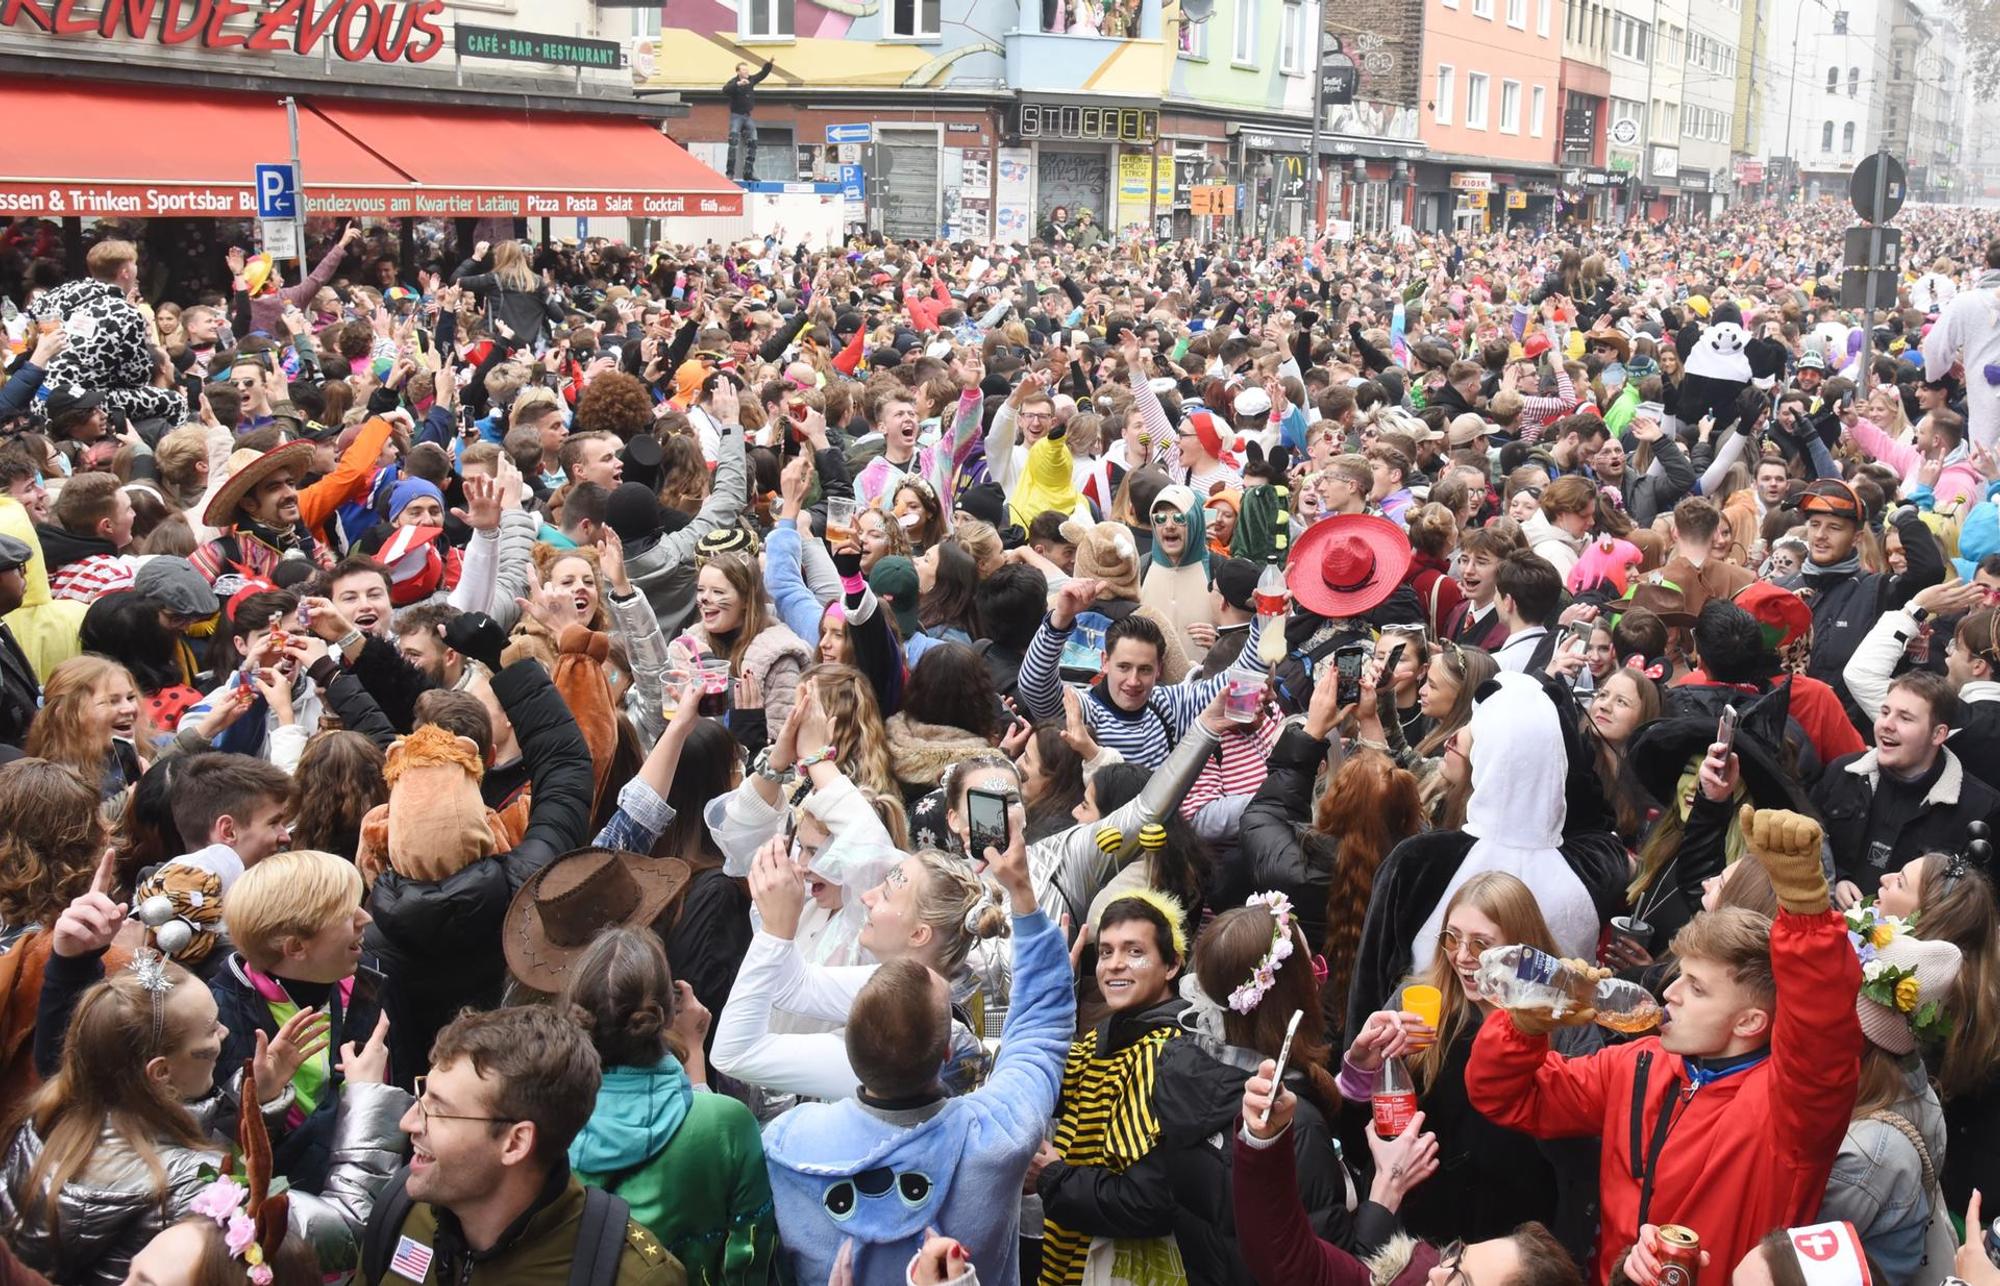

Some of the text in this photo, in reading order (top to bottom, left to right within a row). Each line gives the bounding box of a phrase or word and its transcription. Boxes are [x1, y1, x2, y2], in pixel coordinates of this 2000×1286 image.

[467, 33, 499, 54] CAFÉ
[509, 39, 532, 56] BAR
[542, 43, 614, 65] RESTAURANT
[1022, 107, 1157, 139] STIEFEL
[843, 167, 854, 182] P
[1609, 174, 1625, 184] sky
[48, 189, 65, 211] &
[68, 190, 141, 211] Trinken
[146, 189, 233, 214] Sportsbar
[239, 191, 258, 210] Bu
[391, 198, 411, 212] am
[416, 195, 473, 212] Kwartier
[477, 195, 519, 215] Latäng
[527, 195, 560, 212] Pizza
[566, 196, 598, 212] Pasta
[605, 196, 633, 212] Salat
[643, 196, 684, 212] Cocktail
[262, 171, 284, 211] P
